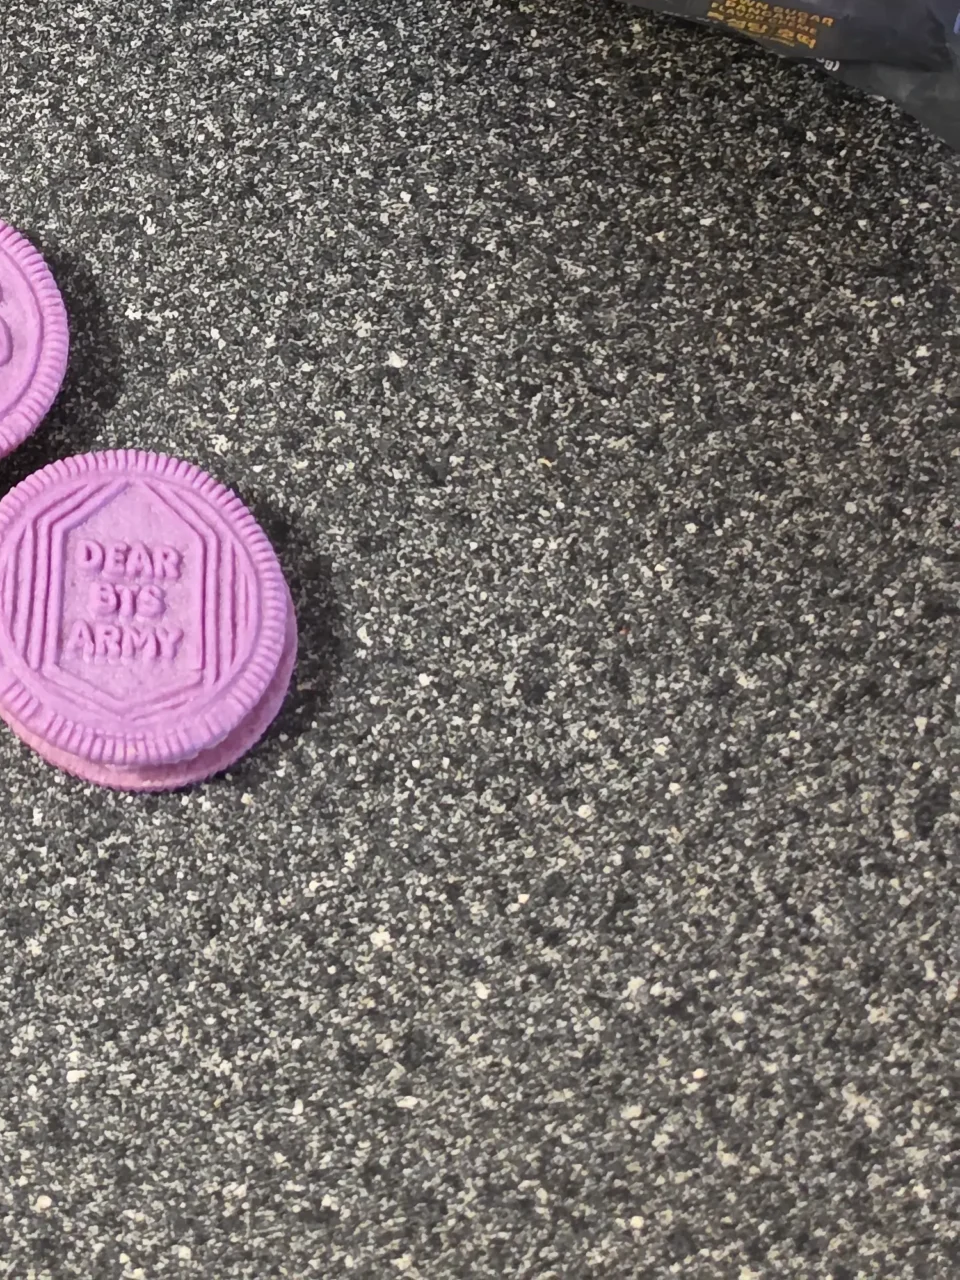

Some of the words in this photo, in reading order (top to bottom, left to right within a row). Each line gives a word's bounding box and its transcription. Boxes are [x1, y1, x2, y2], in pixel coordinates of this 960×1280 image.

[77, 538, 185, 580] DEAR
[91, 582, 167, 621] BTS
[61, 619, 185, 665] ARMY
